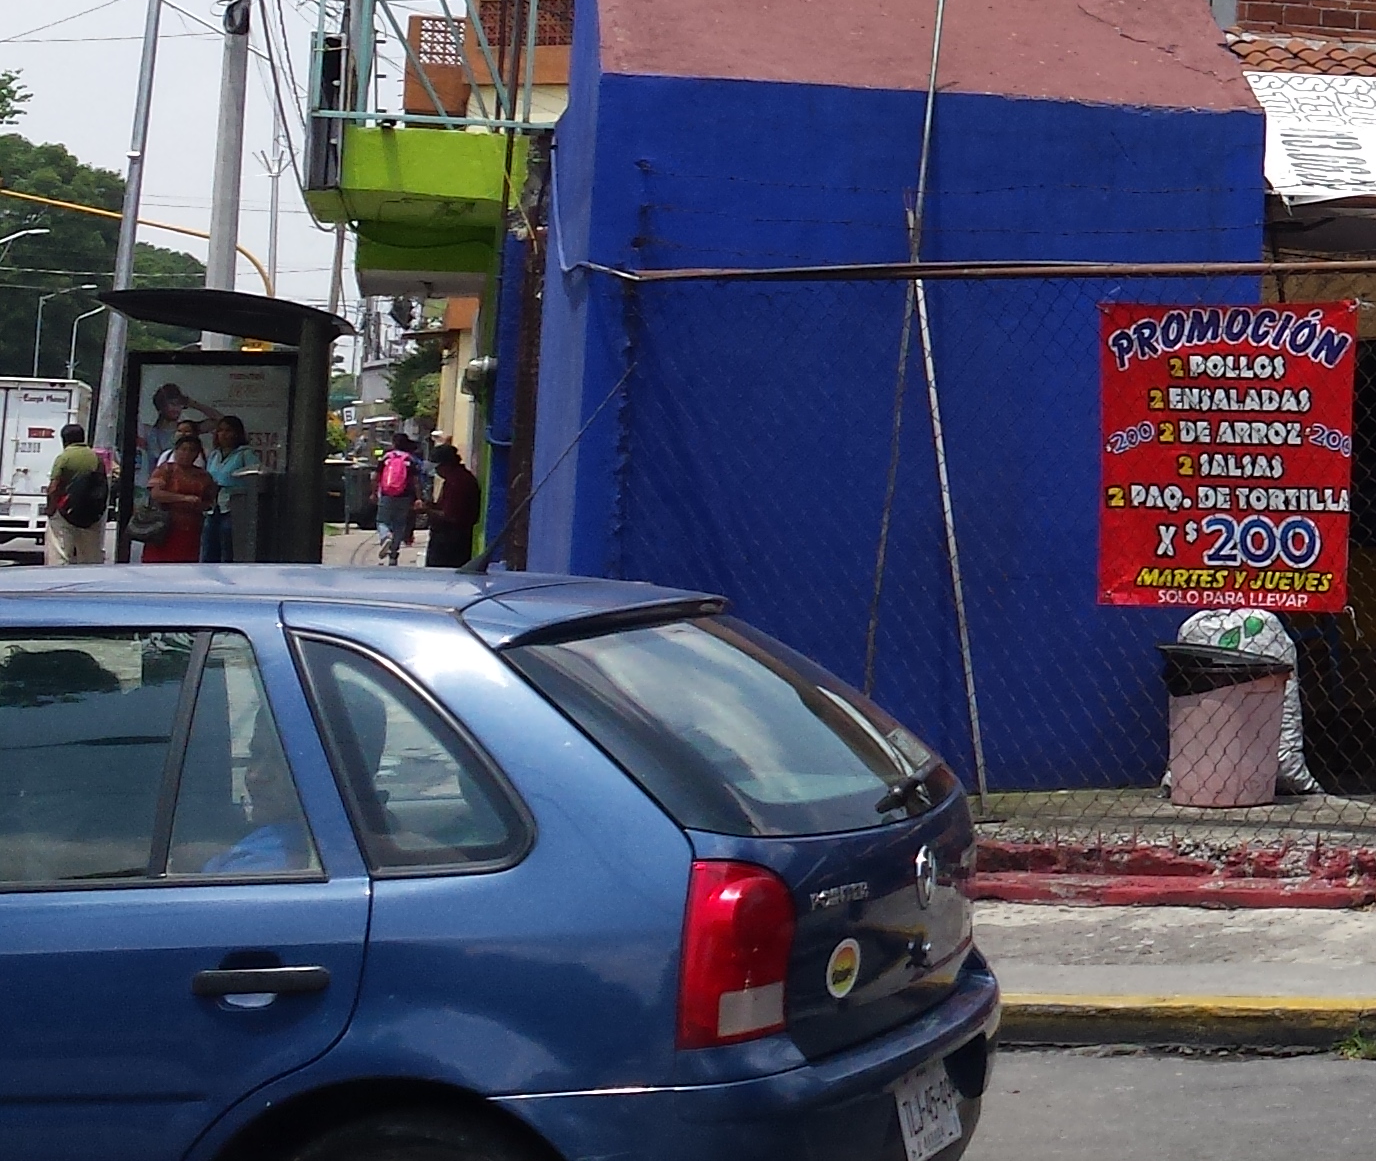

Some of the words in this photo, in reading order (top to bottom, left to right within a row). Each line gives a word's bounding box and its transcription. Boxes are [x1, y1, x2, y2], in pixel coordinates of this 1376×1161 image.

[1108, 307, 1353, 371] PROMOCIÓN
[1169, 356, 1185, 378] 2
[1188, 354, 1286, 380] POLLOS
[1149, 389, 1165, 410] 2
[1168, 386, 1312, 413] ENSALADAS
[1158, 422, 1175, 444] 2
[1179, 420, 1212, 444] DE
[1215, 420, 1304, 446] ARROZ
[1177, 455, 1194, 477] 2
[1198, 453, 1285, 479] SALSAS
[1106, 486, 1126, 509] 2
[1129, 484, 1193, 512] PAQ.
[1196, 485, 1232, 511] DE
[1234, 486, 1352, 513] TORTILLA
[1135, 566, 1230, 591] MARTES
[1233, 569, 1249, 590] Y
[1249, 569, 1334, 593] JUEVES
[1157, 588, 1200, 606] SOLO
[1202, 589, 1247, 607] PARA
[1249, 590, 1309, 609] LLEVAR
